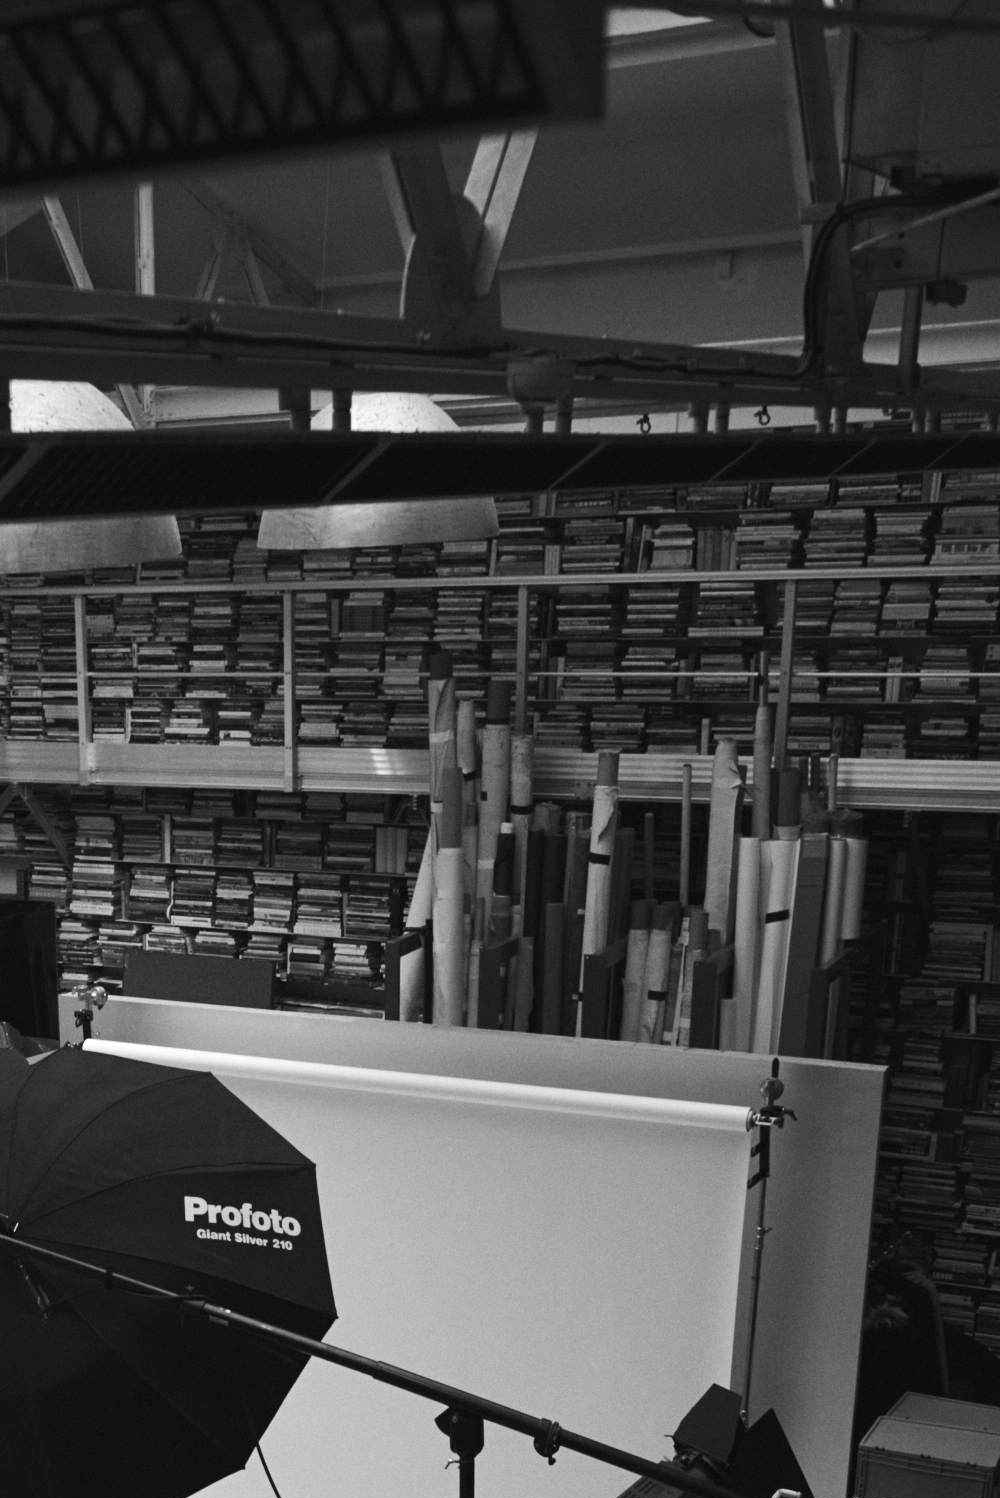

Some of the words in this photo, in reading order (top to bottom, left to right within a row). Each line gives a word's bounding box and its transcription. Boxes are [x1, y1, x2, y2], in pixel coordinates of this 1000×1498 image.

[184, 1196, 301, 1236] Profoto
[196, 1229, 231, 1242] Giant
[234, 1232, 268, 1247] Silver
[272, 1239, 293, 1250] 210
